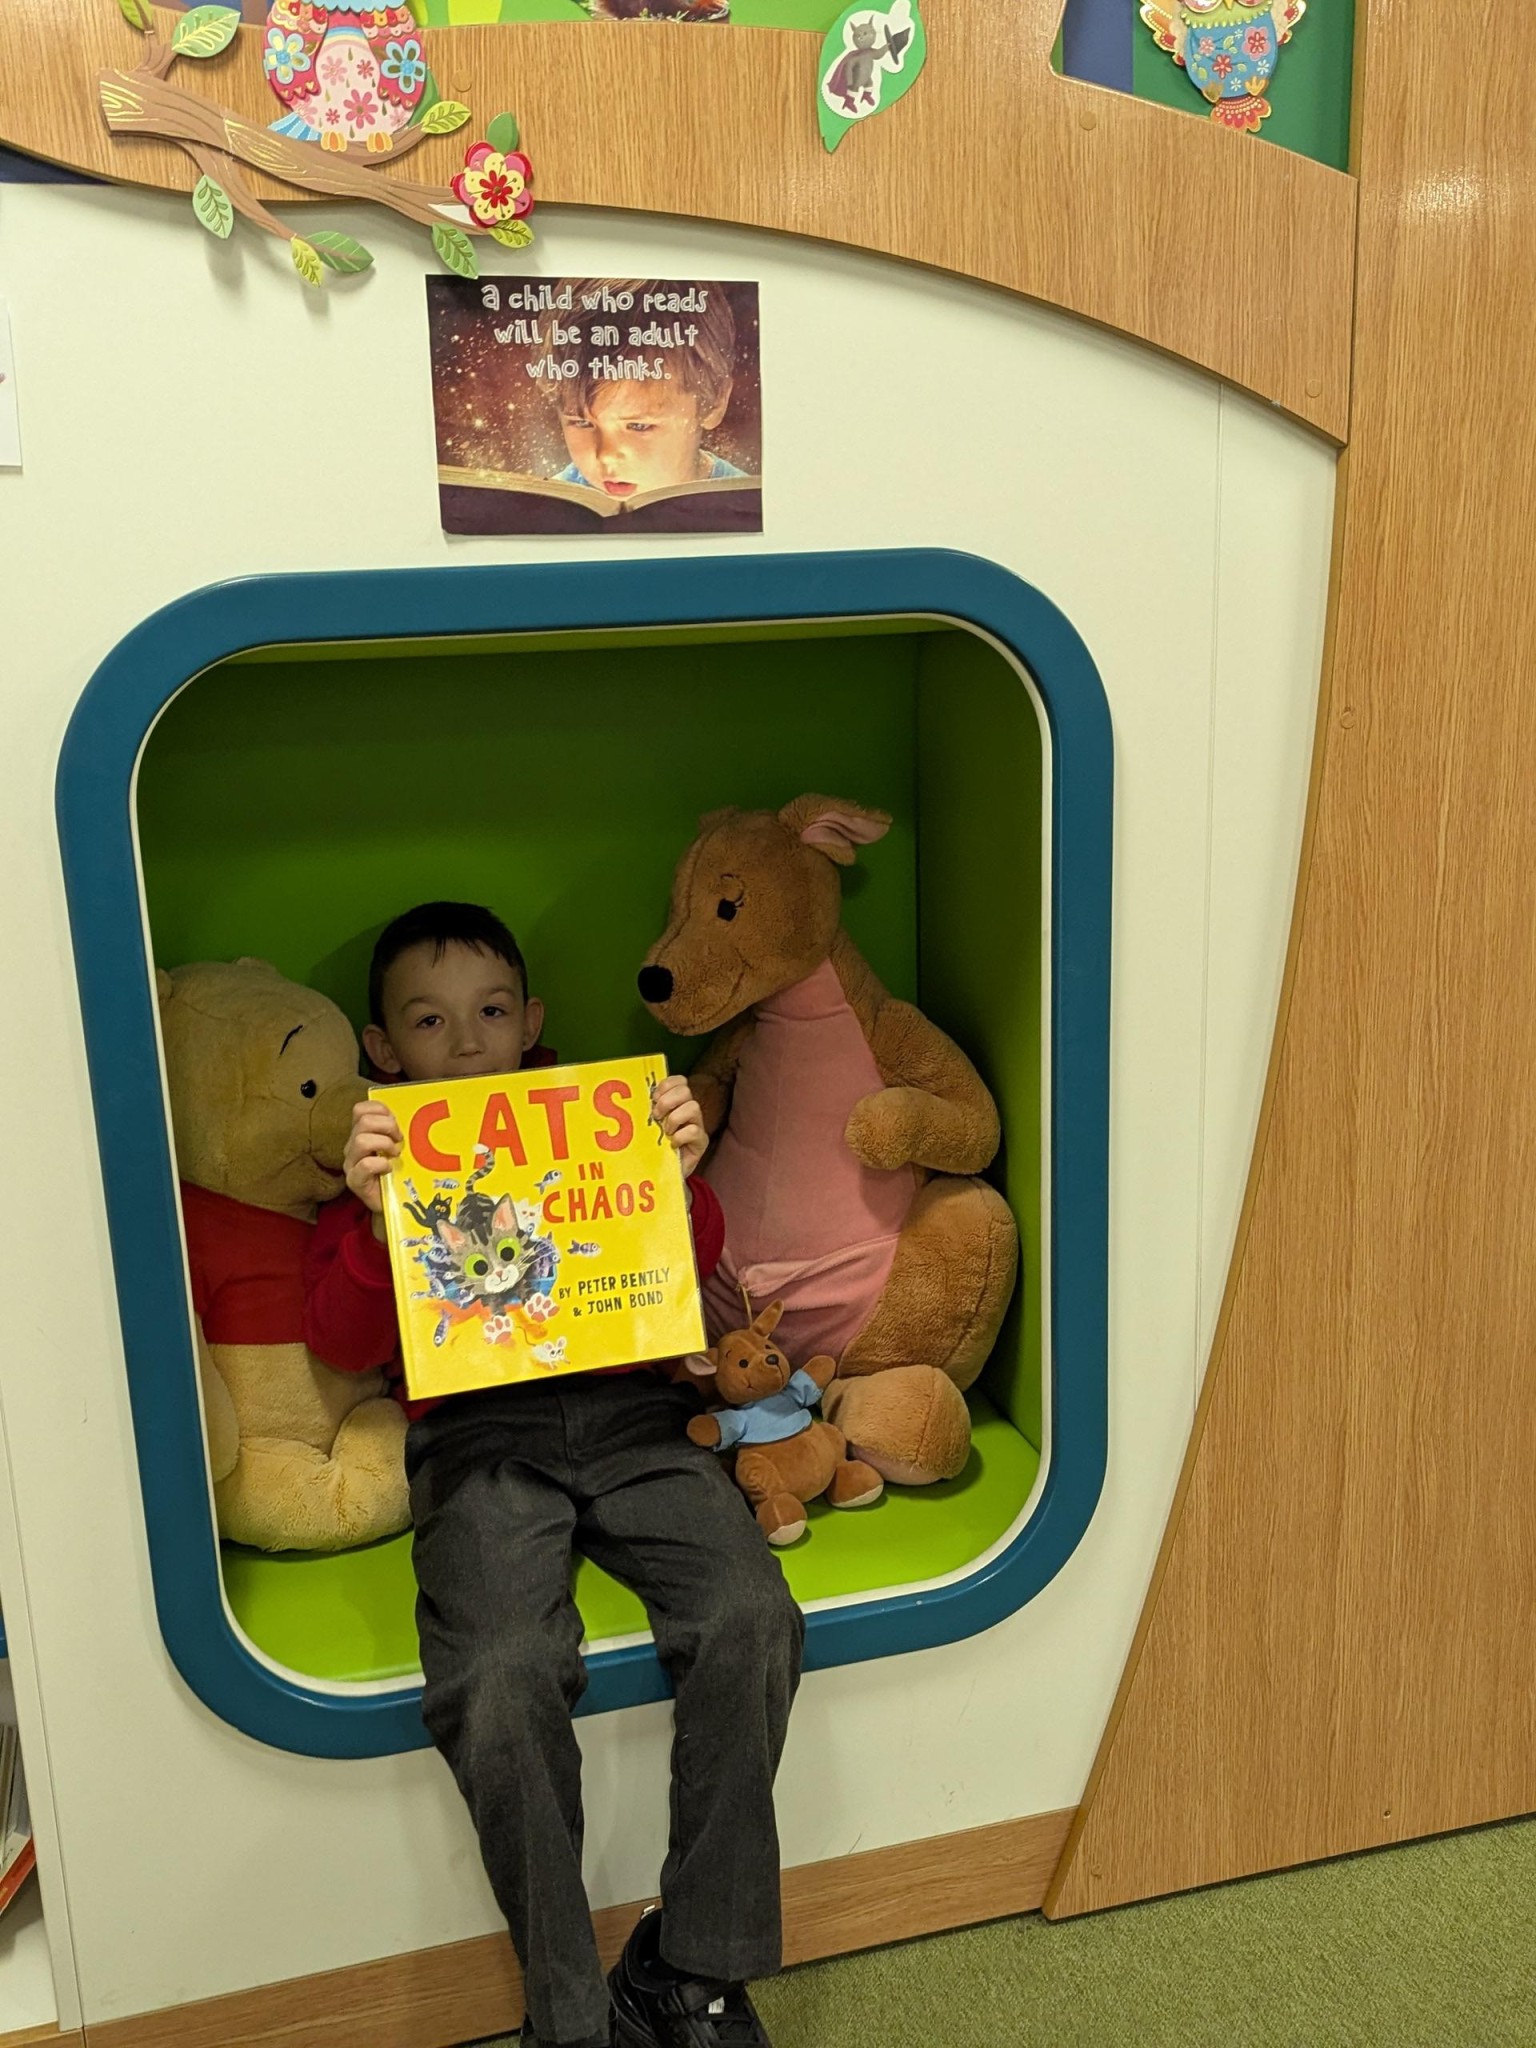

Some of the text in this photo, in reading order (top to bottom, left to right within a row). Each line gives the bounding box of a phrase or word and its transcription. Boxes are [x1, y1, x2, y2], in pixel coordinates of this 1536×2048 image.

[508, 284, 572, 311] child
[581, 286, 634, 313] who
[643, 287, 709, 313] reads
[493, 320, 699, 348] will be an adult
[525, 354, 672, 381] who thinks.
[408, 1079, 634, 1172] CATS
[578, 1161, 604, 1181] IN
[542, 1180, 655, 1223] CHAOS
[558, 1267, 670, 1299] BY PETER BENTLY
[573, 1290, 664, 1317] & JOHN BOND
